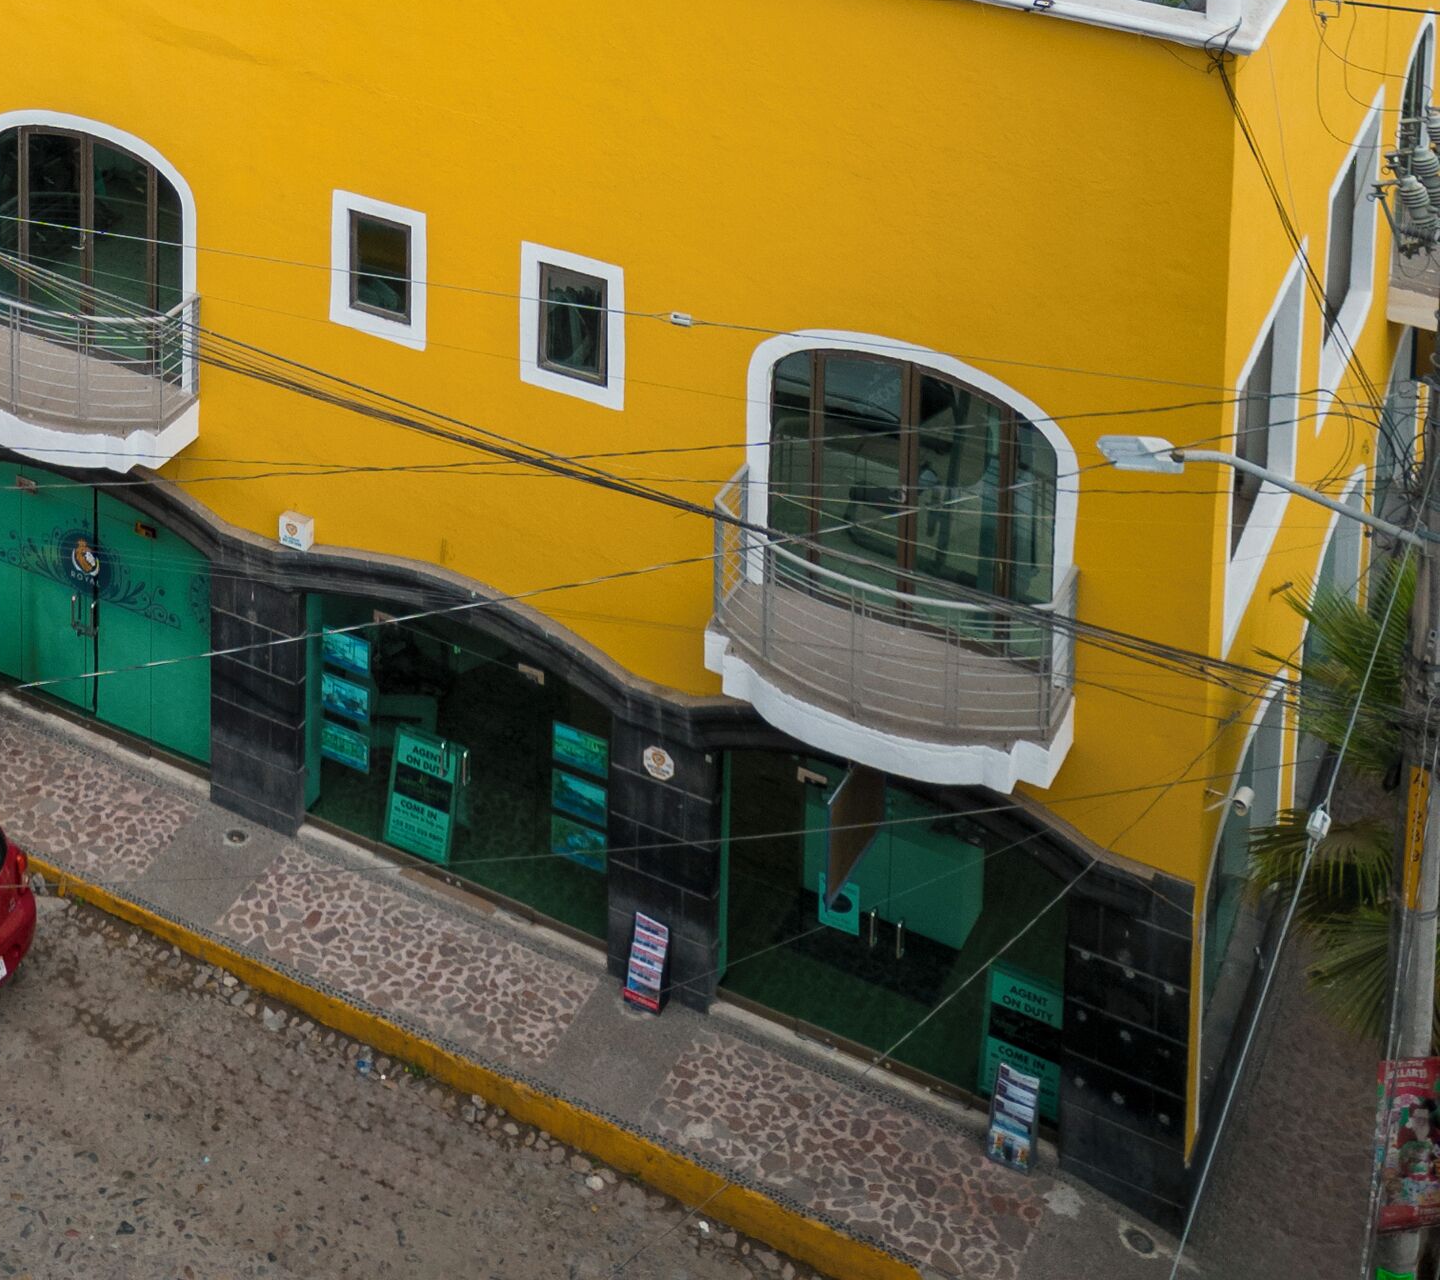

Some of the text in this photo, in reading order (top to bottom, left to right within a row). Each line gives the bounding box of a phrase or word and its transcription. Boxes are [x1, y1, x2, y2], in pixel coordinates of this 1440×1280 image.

[71, 570, 101, 588] ROYAL
[406, 755, 442, 775] ON DUT
[400, 800, 438, 821] COME IN
[1010, 985, 1049, 1007] AGENT
[1002, 995, 1054, 1021] ON DUTY
[999, 1046, 1046, 1071] COME IN
